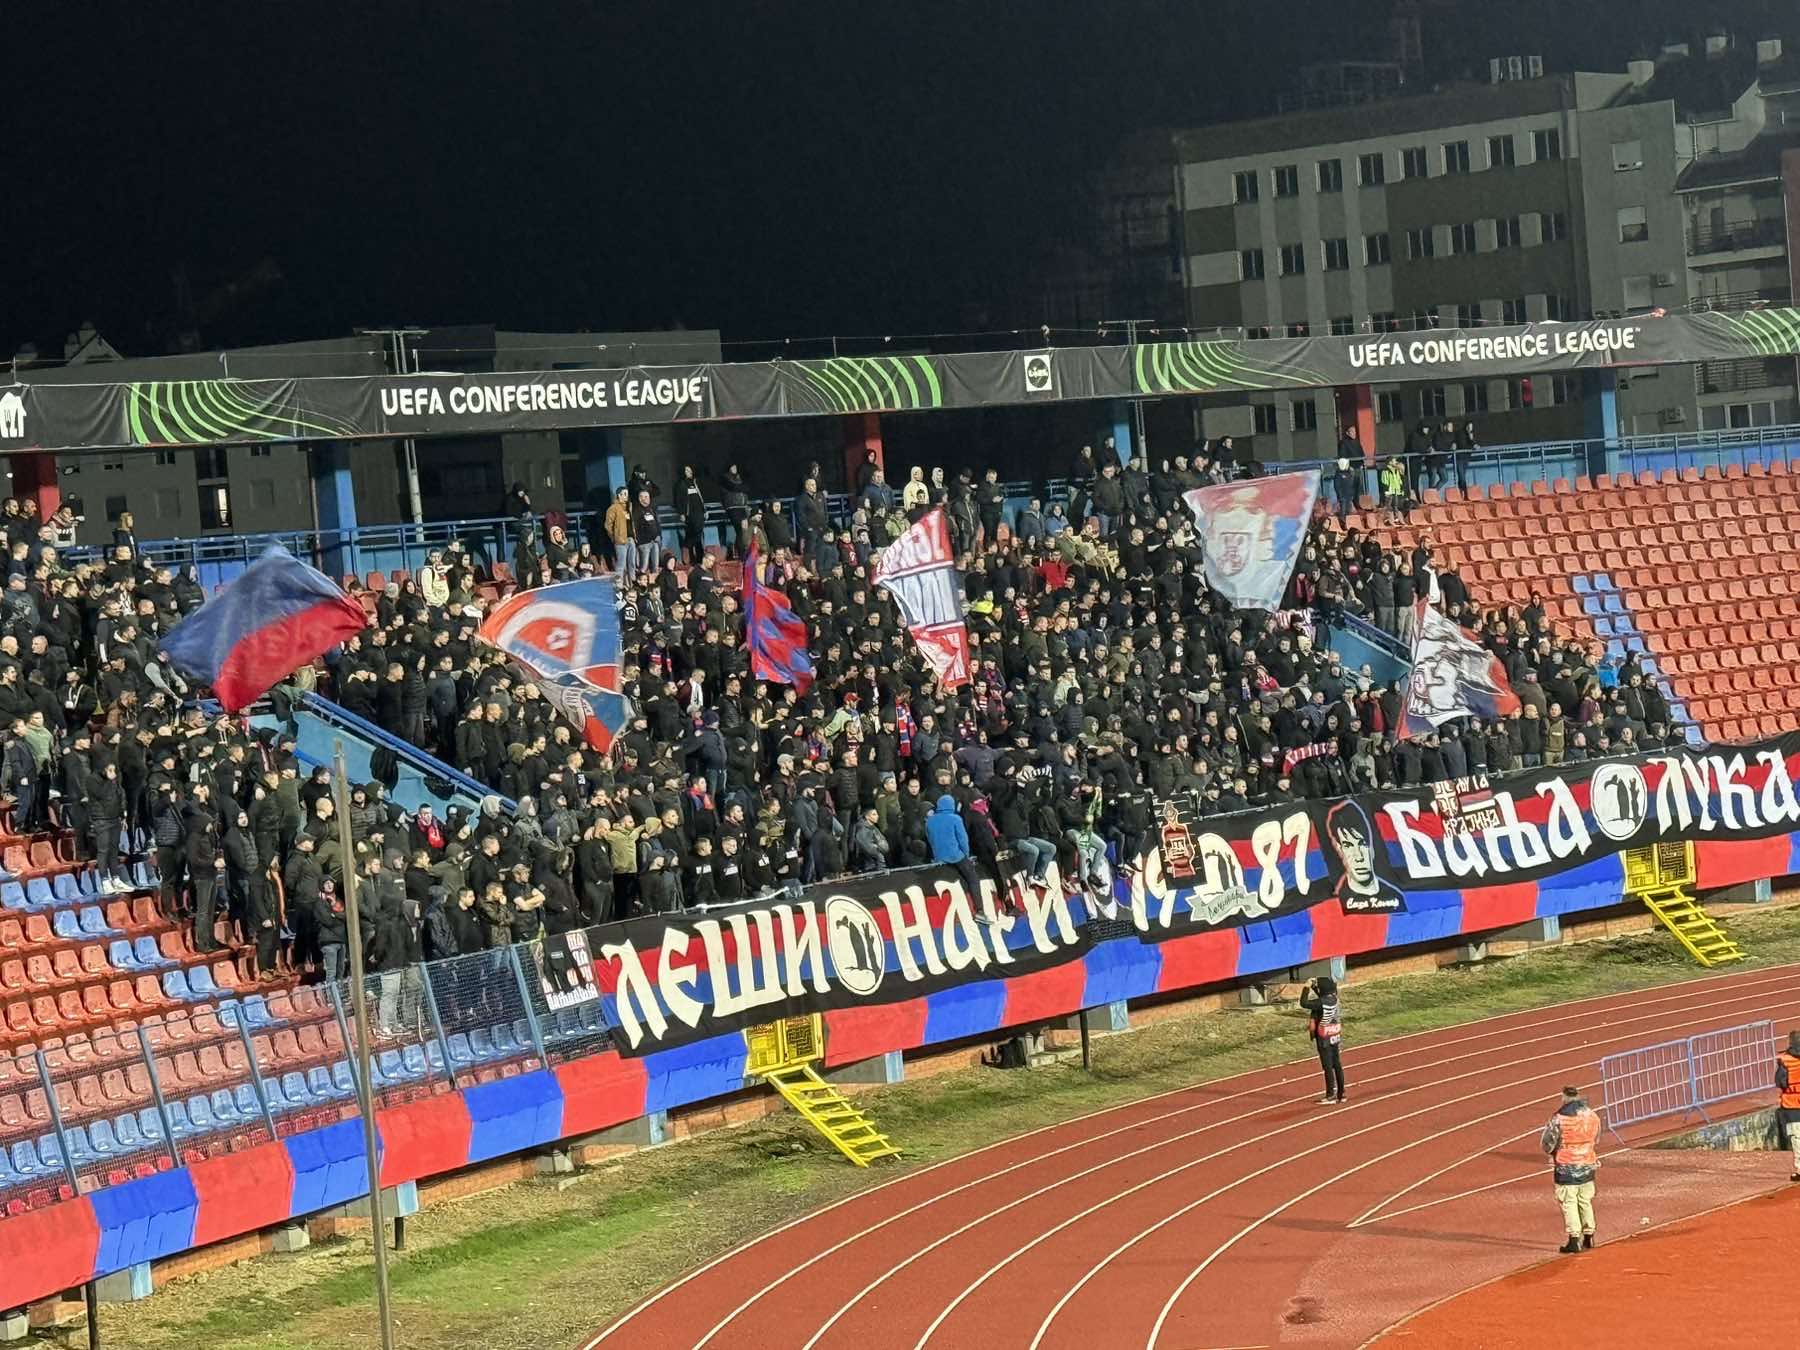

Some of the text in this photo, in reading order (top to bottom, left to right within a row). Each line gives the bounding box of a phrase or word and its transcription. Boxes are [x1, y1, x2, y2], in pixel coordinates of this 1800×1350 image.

[1349, 327, 1635, 367] UEFA CONFERENCE LEAGUE
[380, 377, 703, 416] UEFA CONFERENCE LEAGUE
